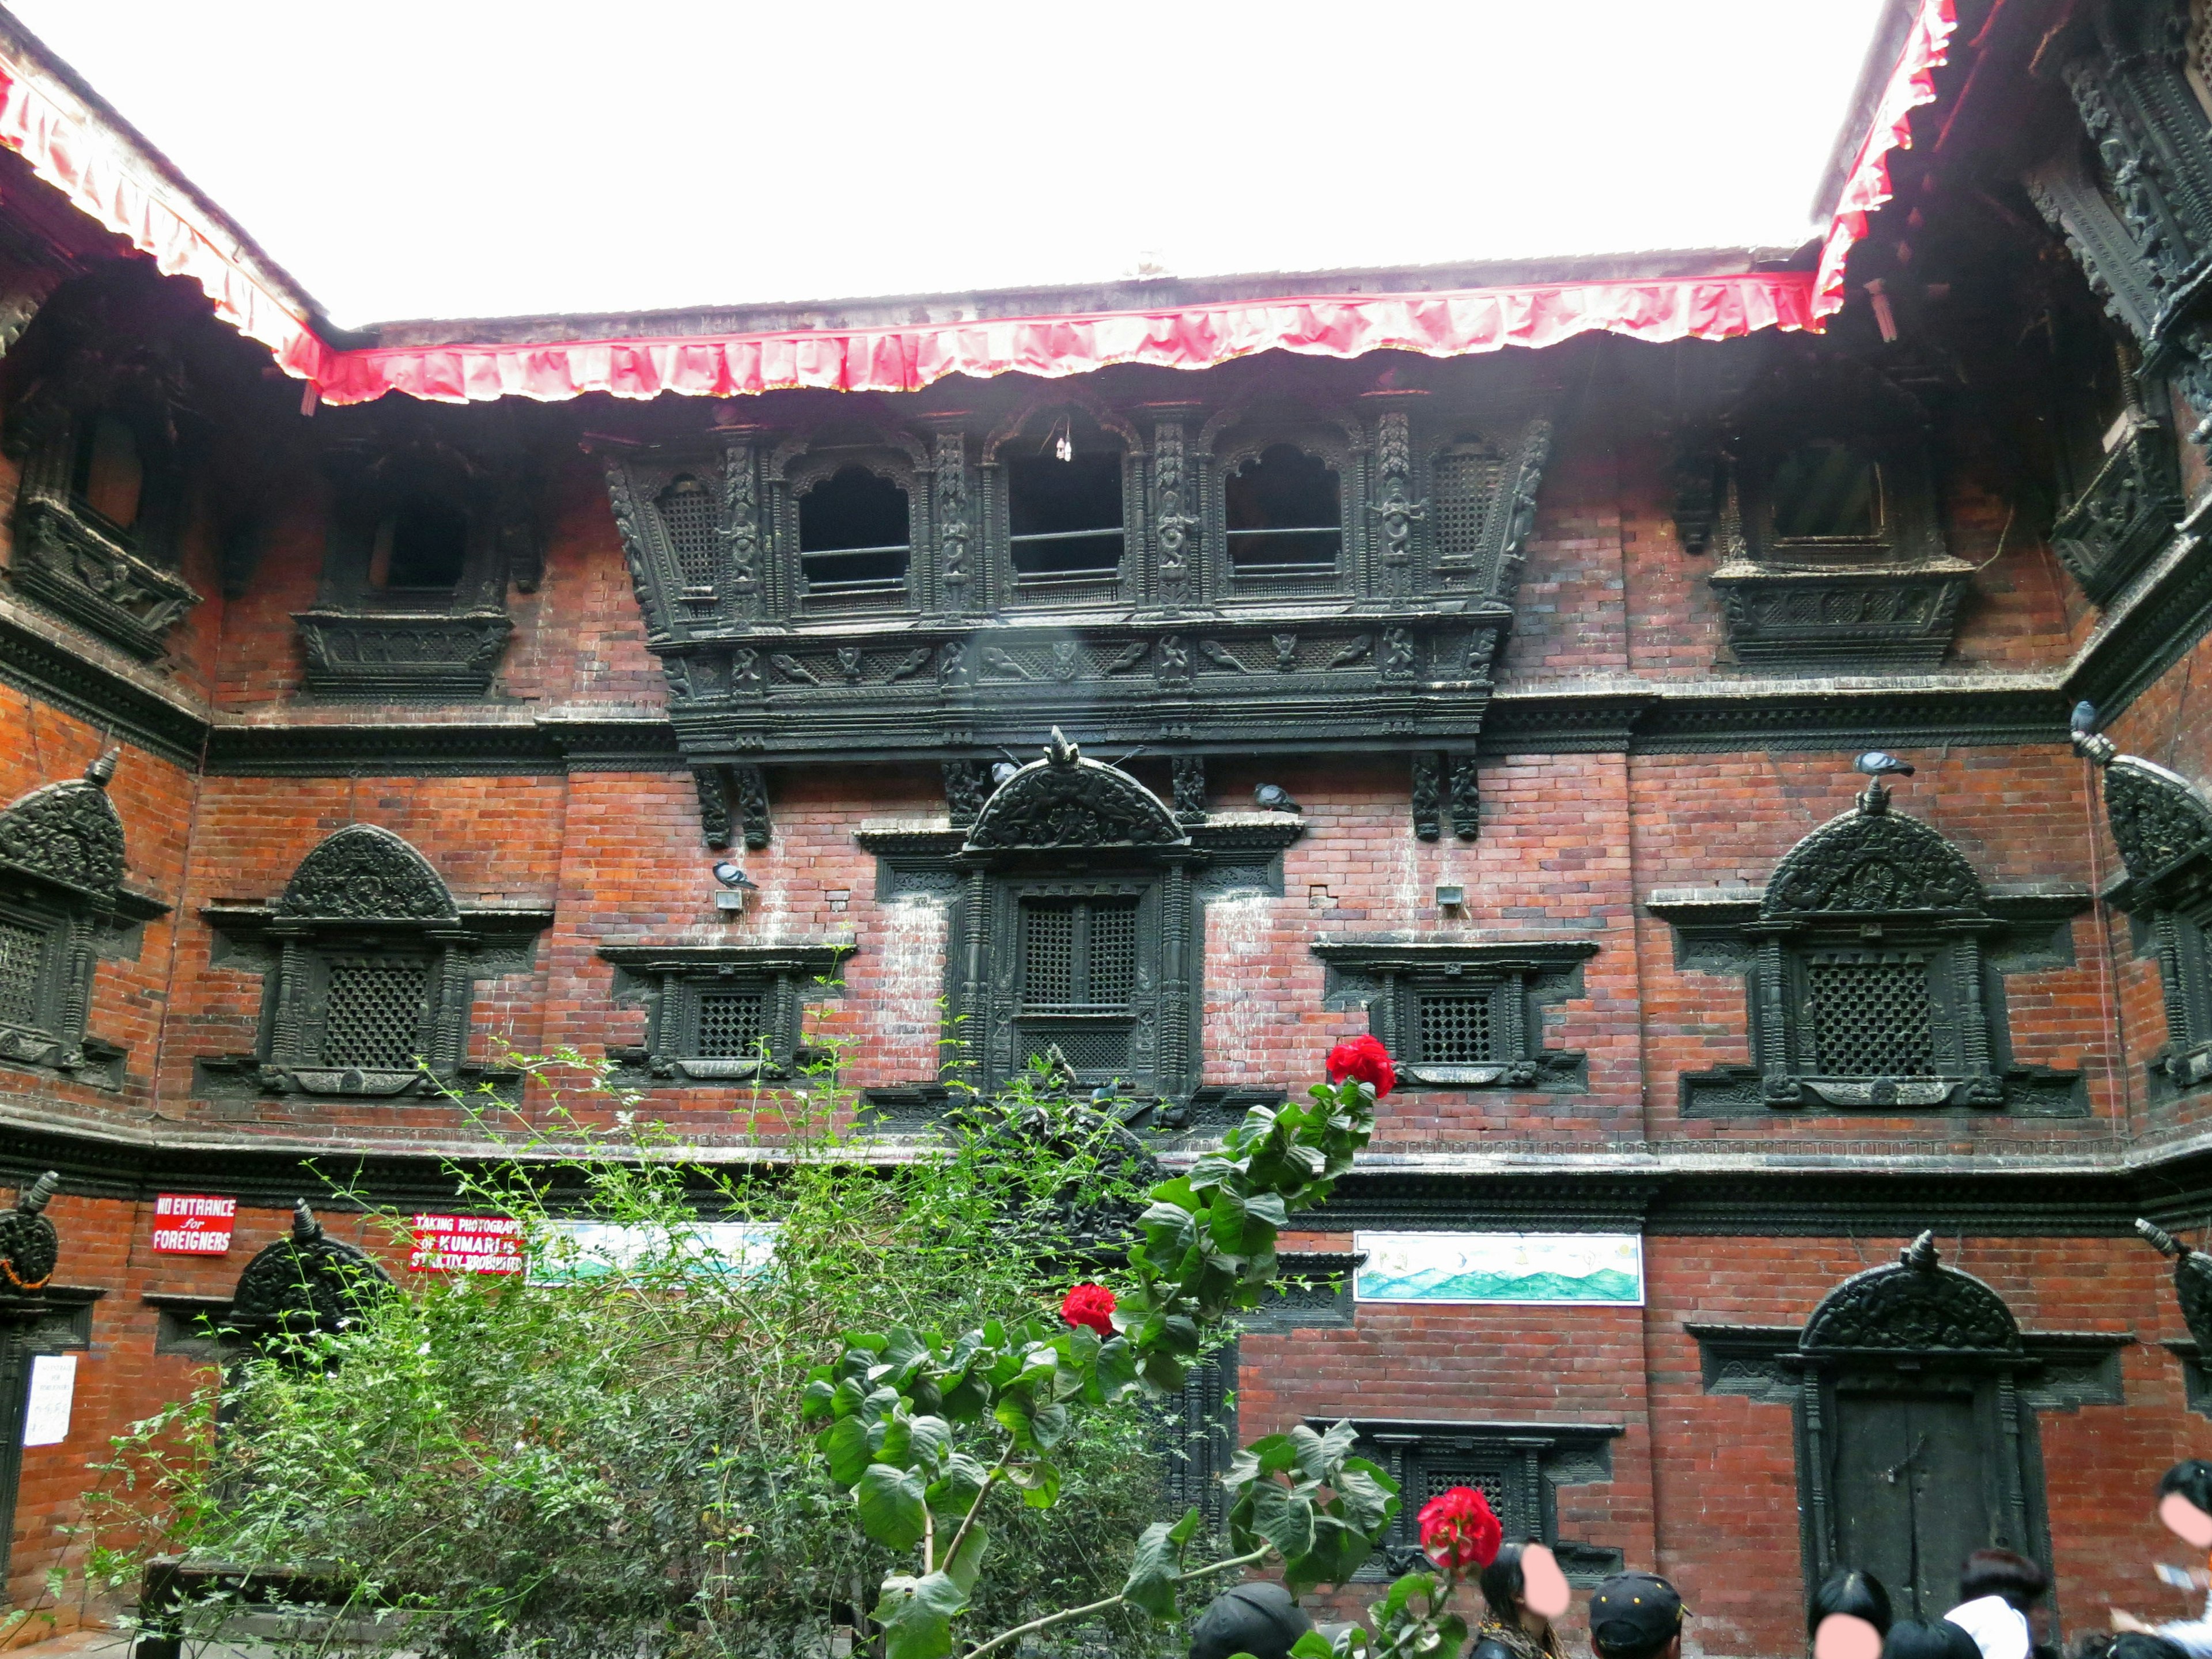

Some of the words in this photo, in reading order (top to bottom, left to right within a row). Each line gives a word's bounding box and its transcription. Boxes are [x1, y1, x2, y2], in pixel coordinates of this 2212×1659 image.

[157, 1198, 172, 1215] NO
[173, 1198, 236, 1217] ENTRANCE
[180, 1218, 205, 1229] for
[416, 1216, 454, 1231] TAKING
[154, 1230, 232, 1251] FOREIGNERS
[439, 1235, 501, 1253] KUMARI
[503, 1241, 516, 1255] IS
